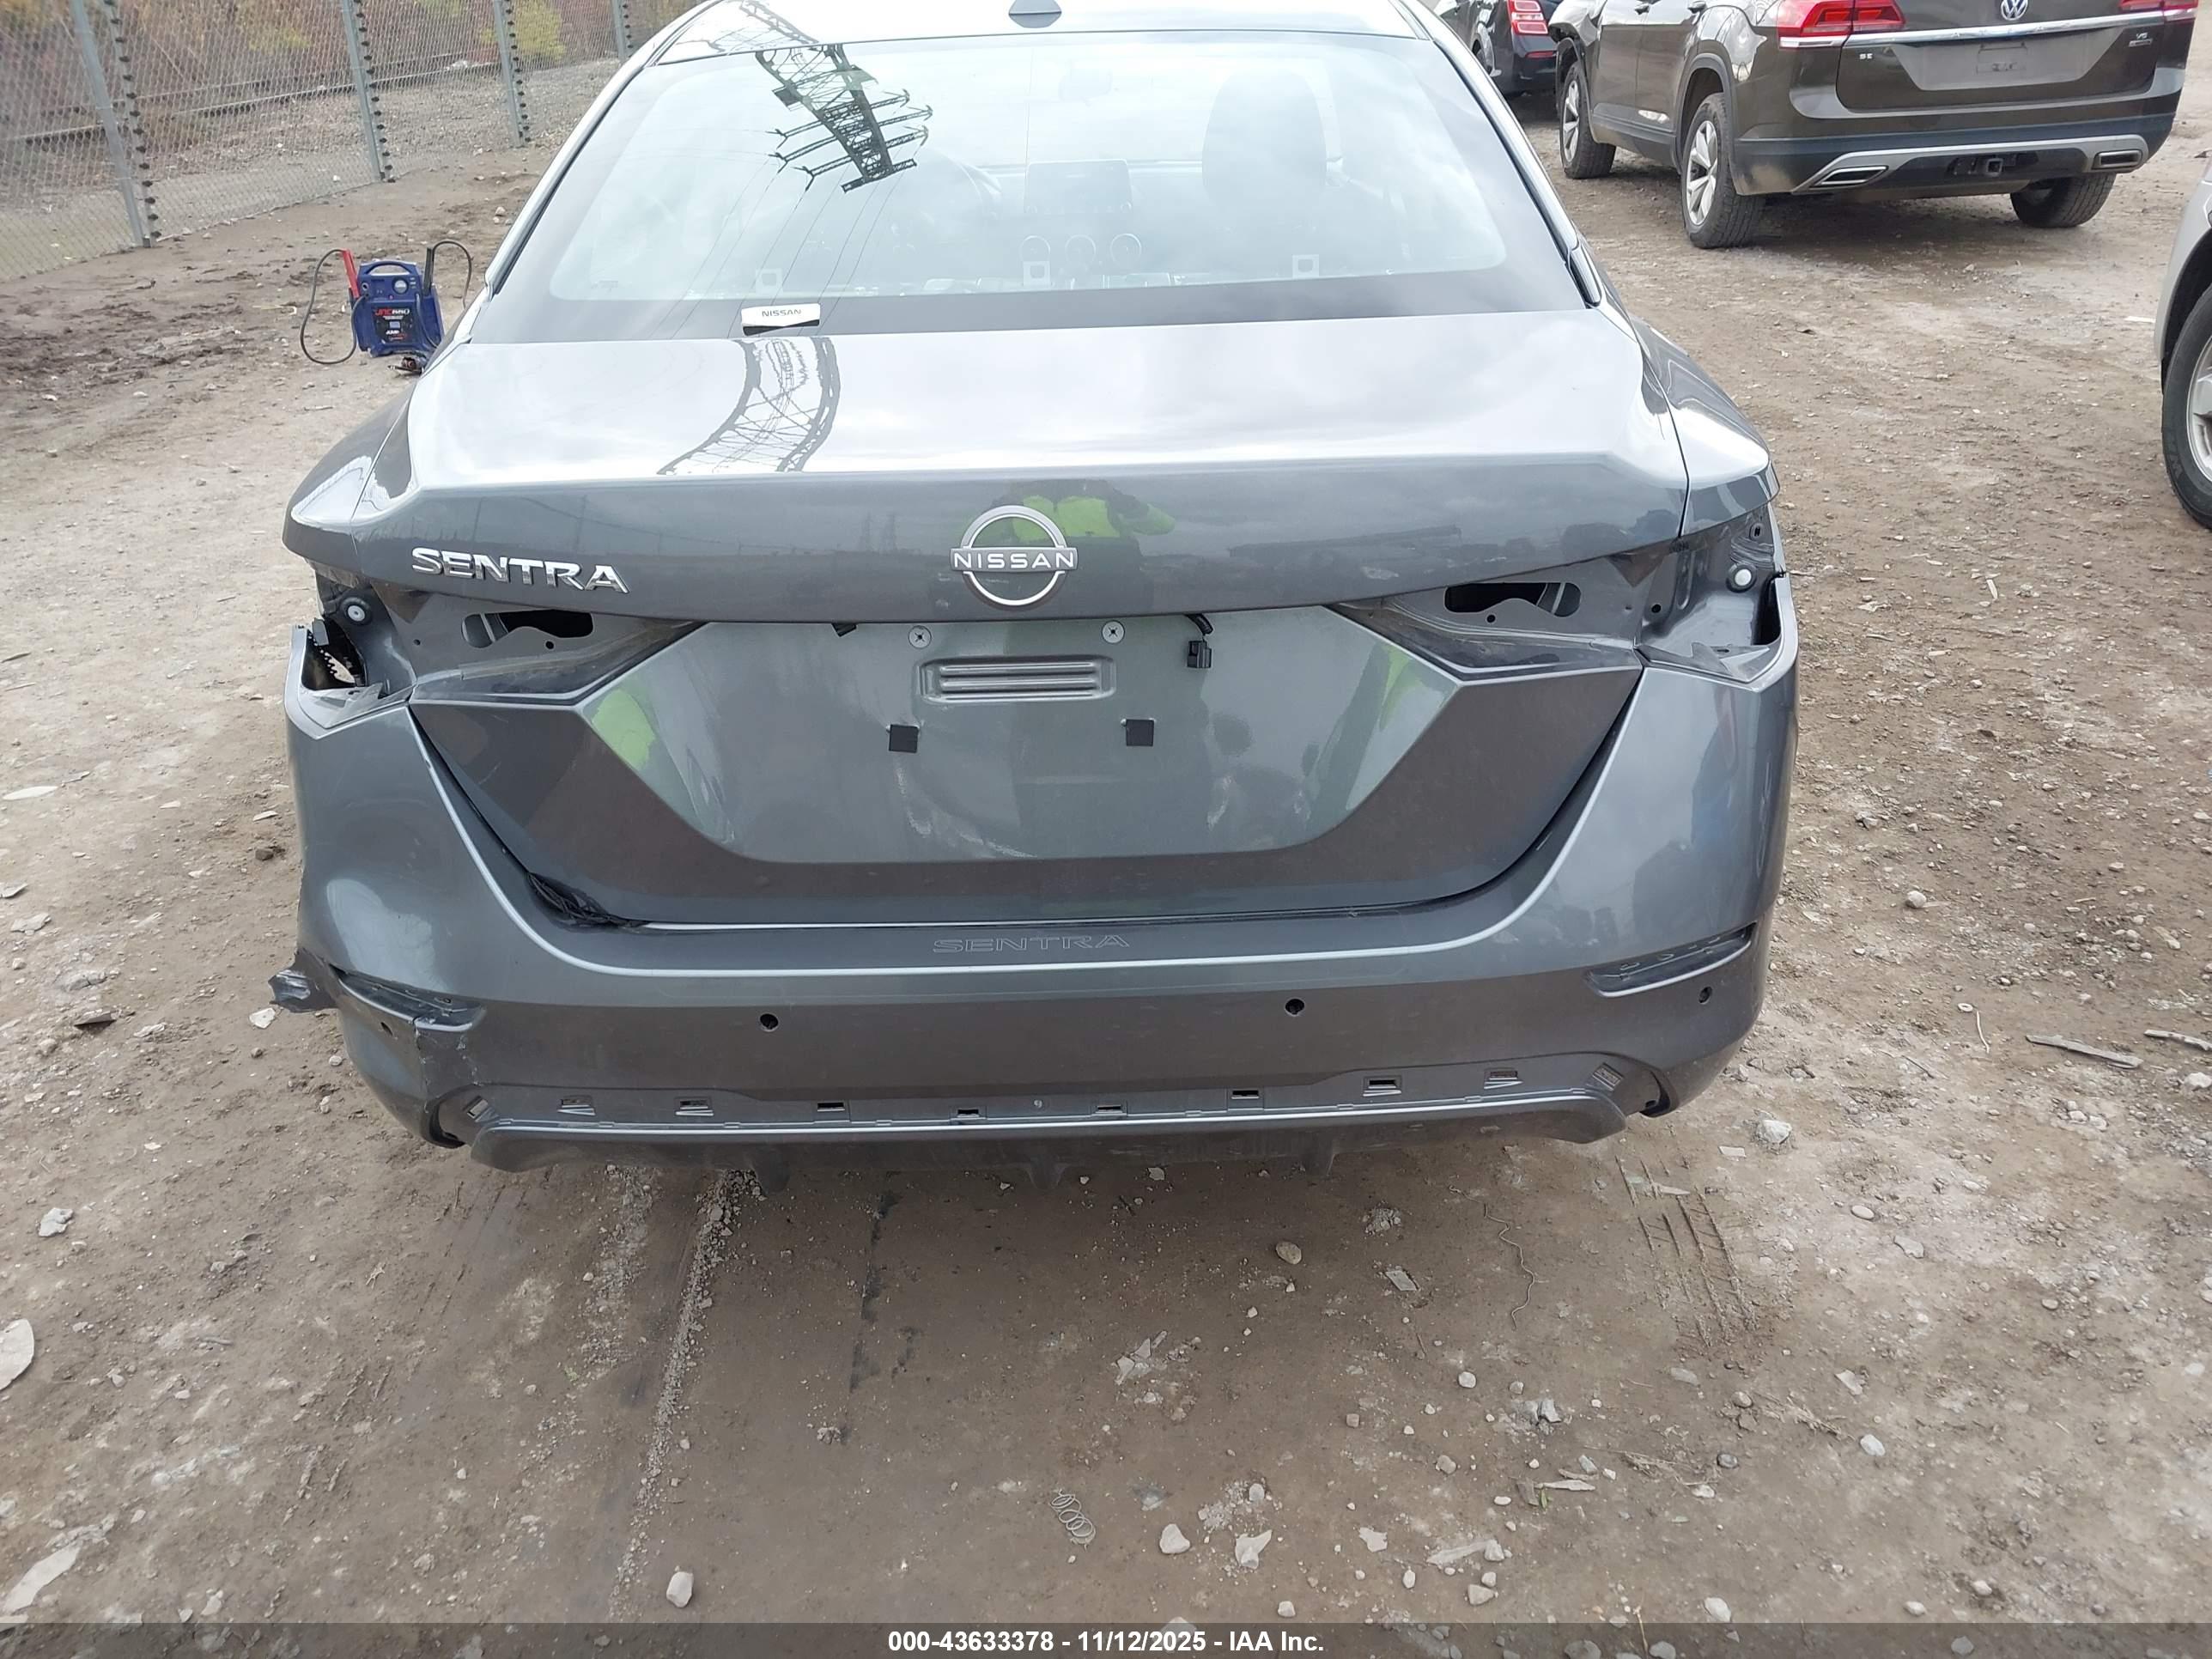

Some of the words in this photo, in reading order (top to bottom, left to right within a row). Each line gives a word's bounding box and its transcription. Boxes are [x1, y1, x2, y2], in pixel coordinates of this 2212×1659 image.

[954, 553, 1074, 568] NISSAN
[411, 547, 630, 593] SENTRA
[933, 934, 1130, 952] SENTRA
